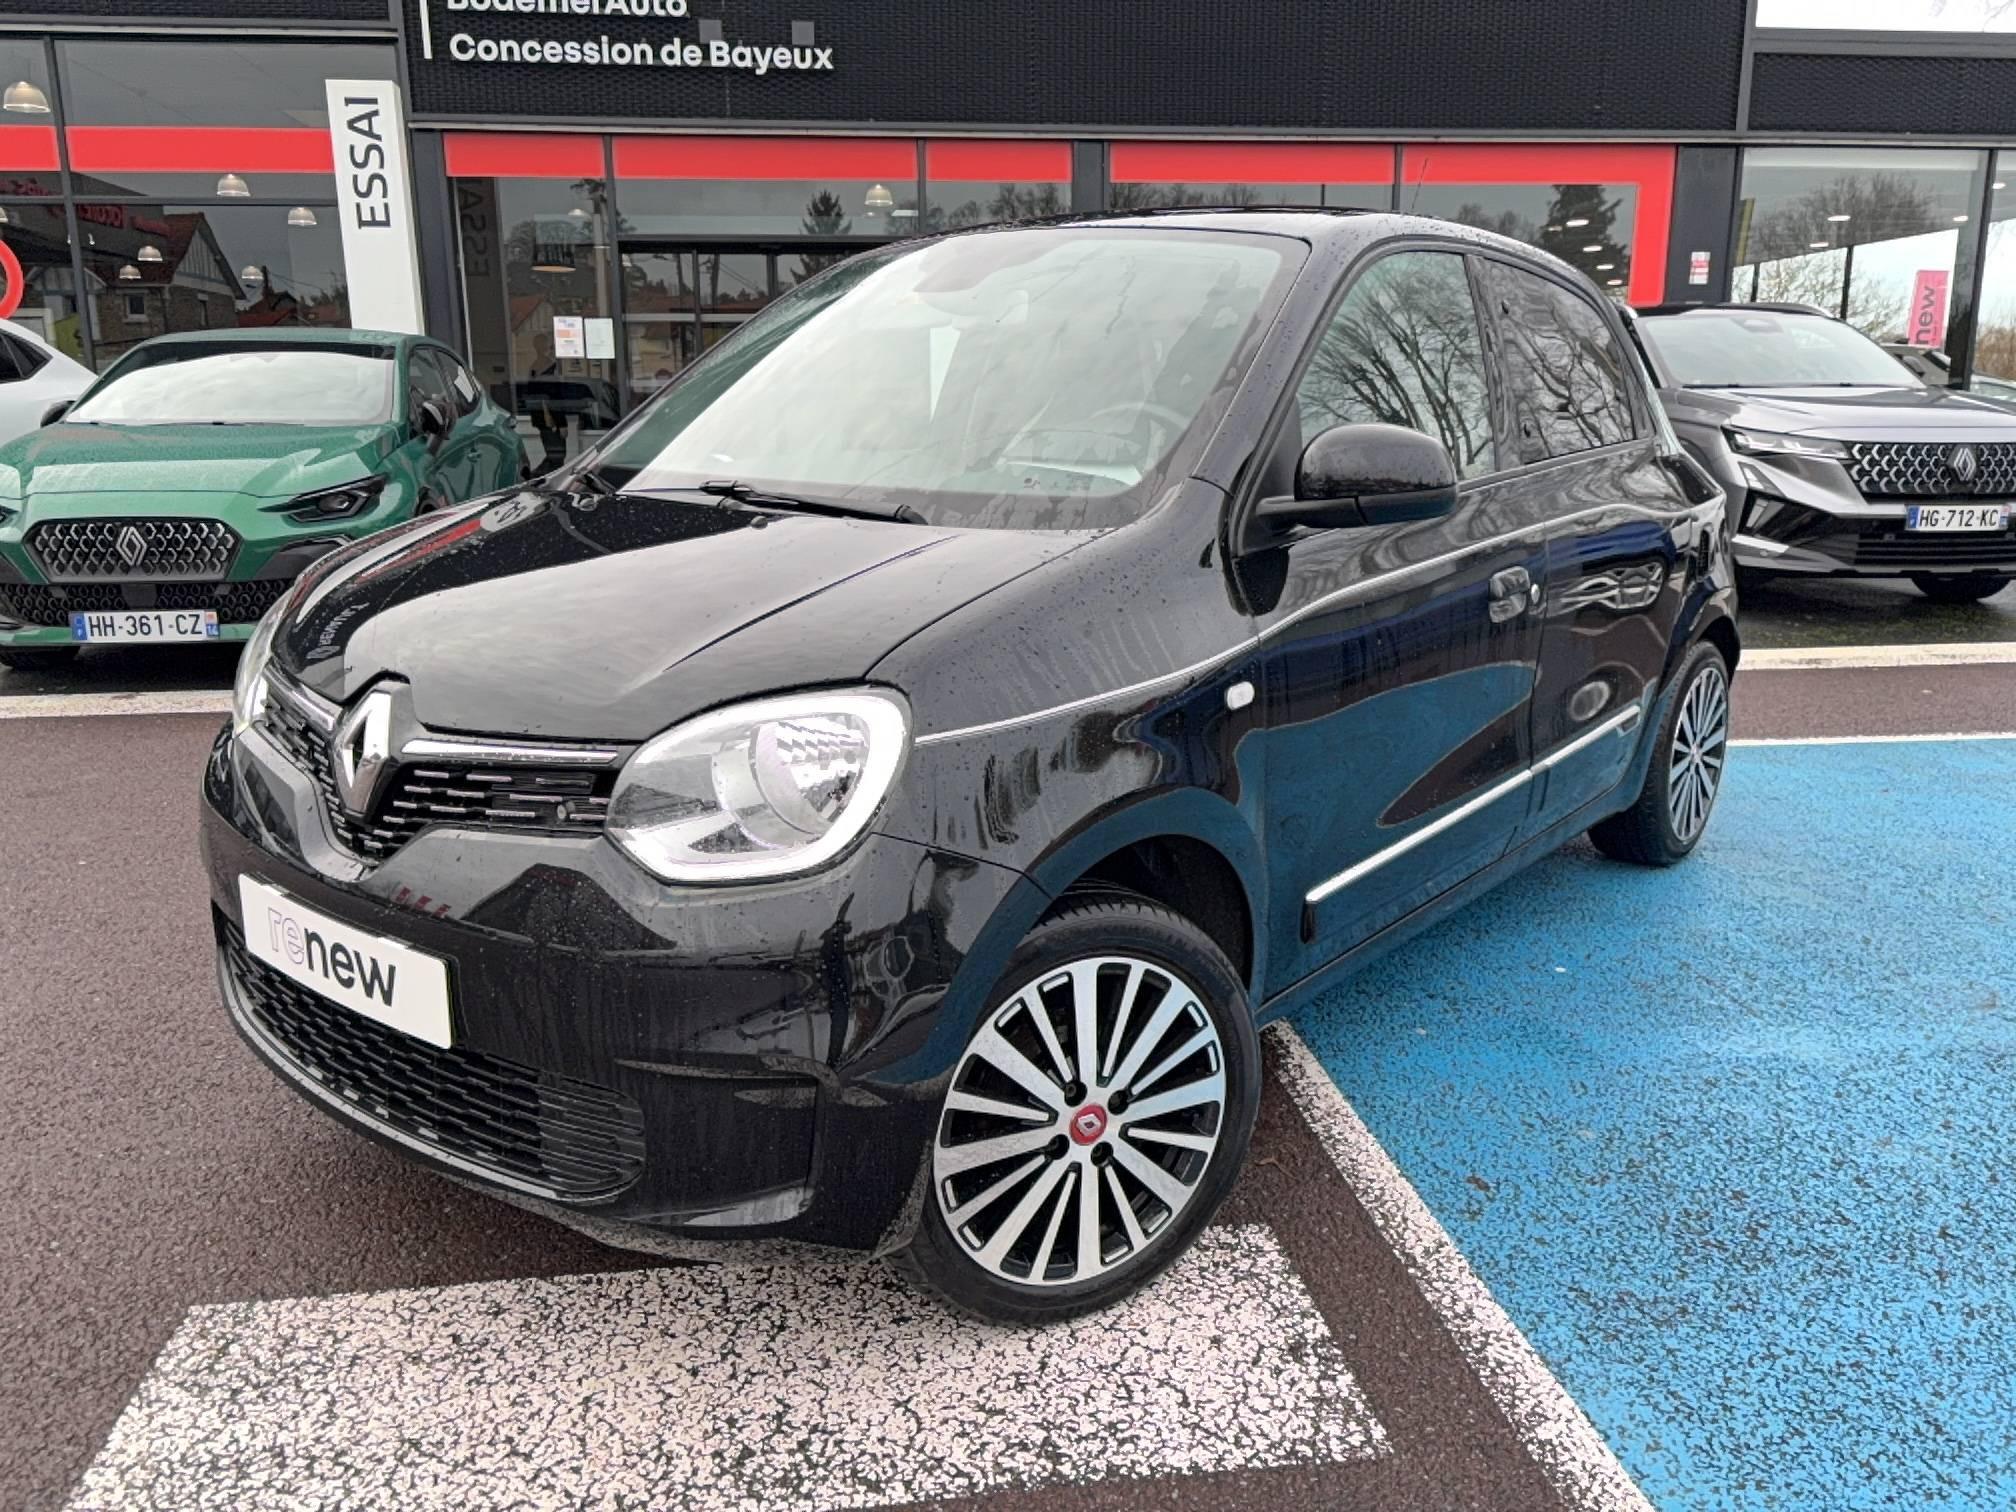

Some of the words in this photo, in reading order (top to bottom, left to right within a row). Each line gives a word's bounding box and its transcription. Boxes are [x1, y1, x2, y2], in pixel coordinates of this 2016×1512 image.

[449, 33, 653, 65] Concession
[660, 37, 702, 66] de
[709, 40, 834, 75] Bayeux
[344, 96, 391, 230] ESSAI
[1919, 509, 1999, 527] HG-712-KC
[88, 614, 203, 637] HH-361-CZ
[267, 907, 396, 1008] renew
